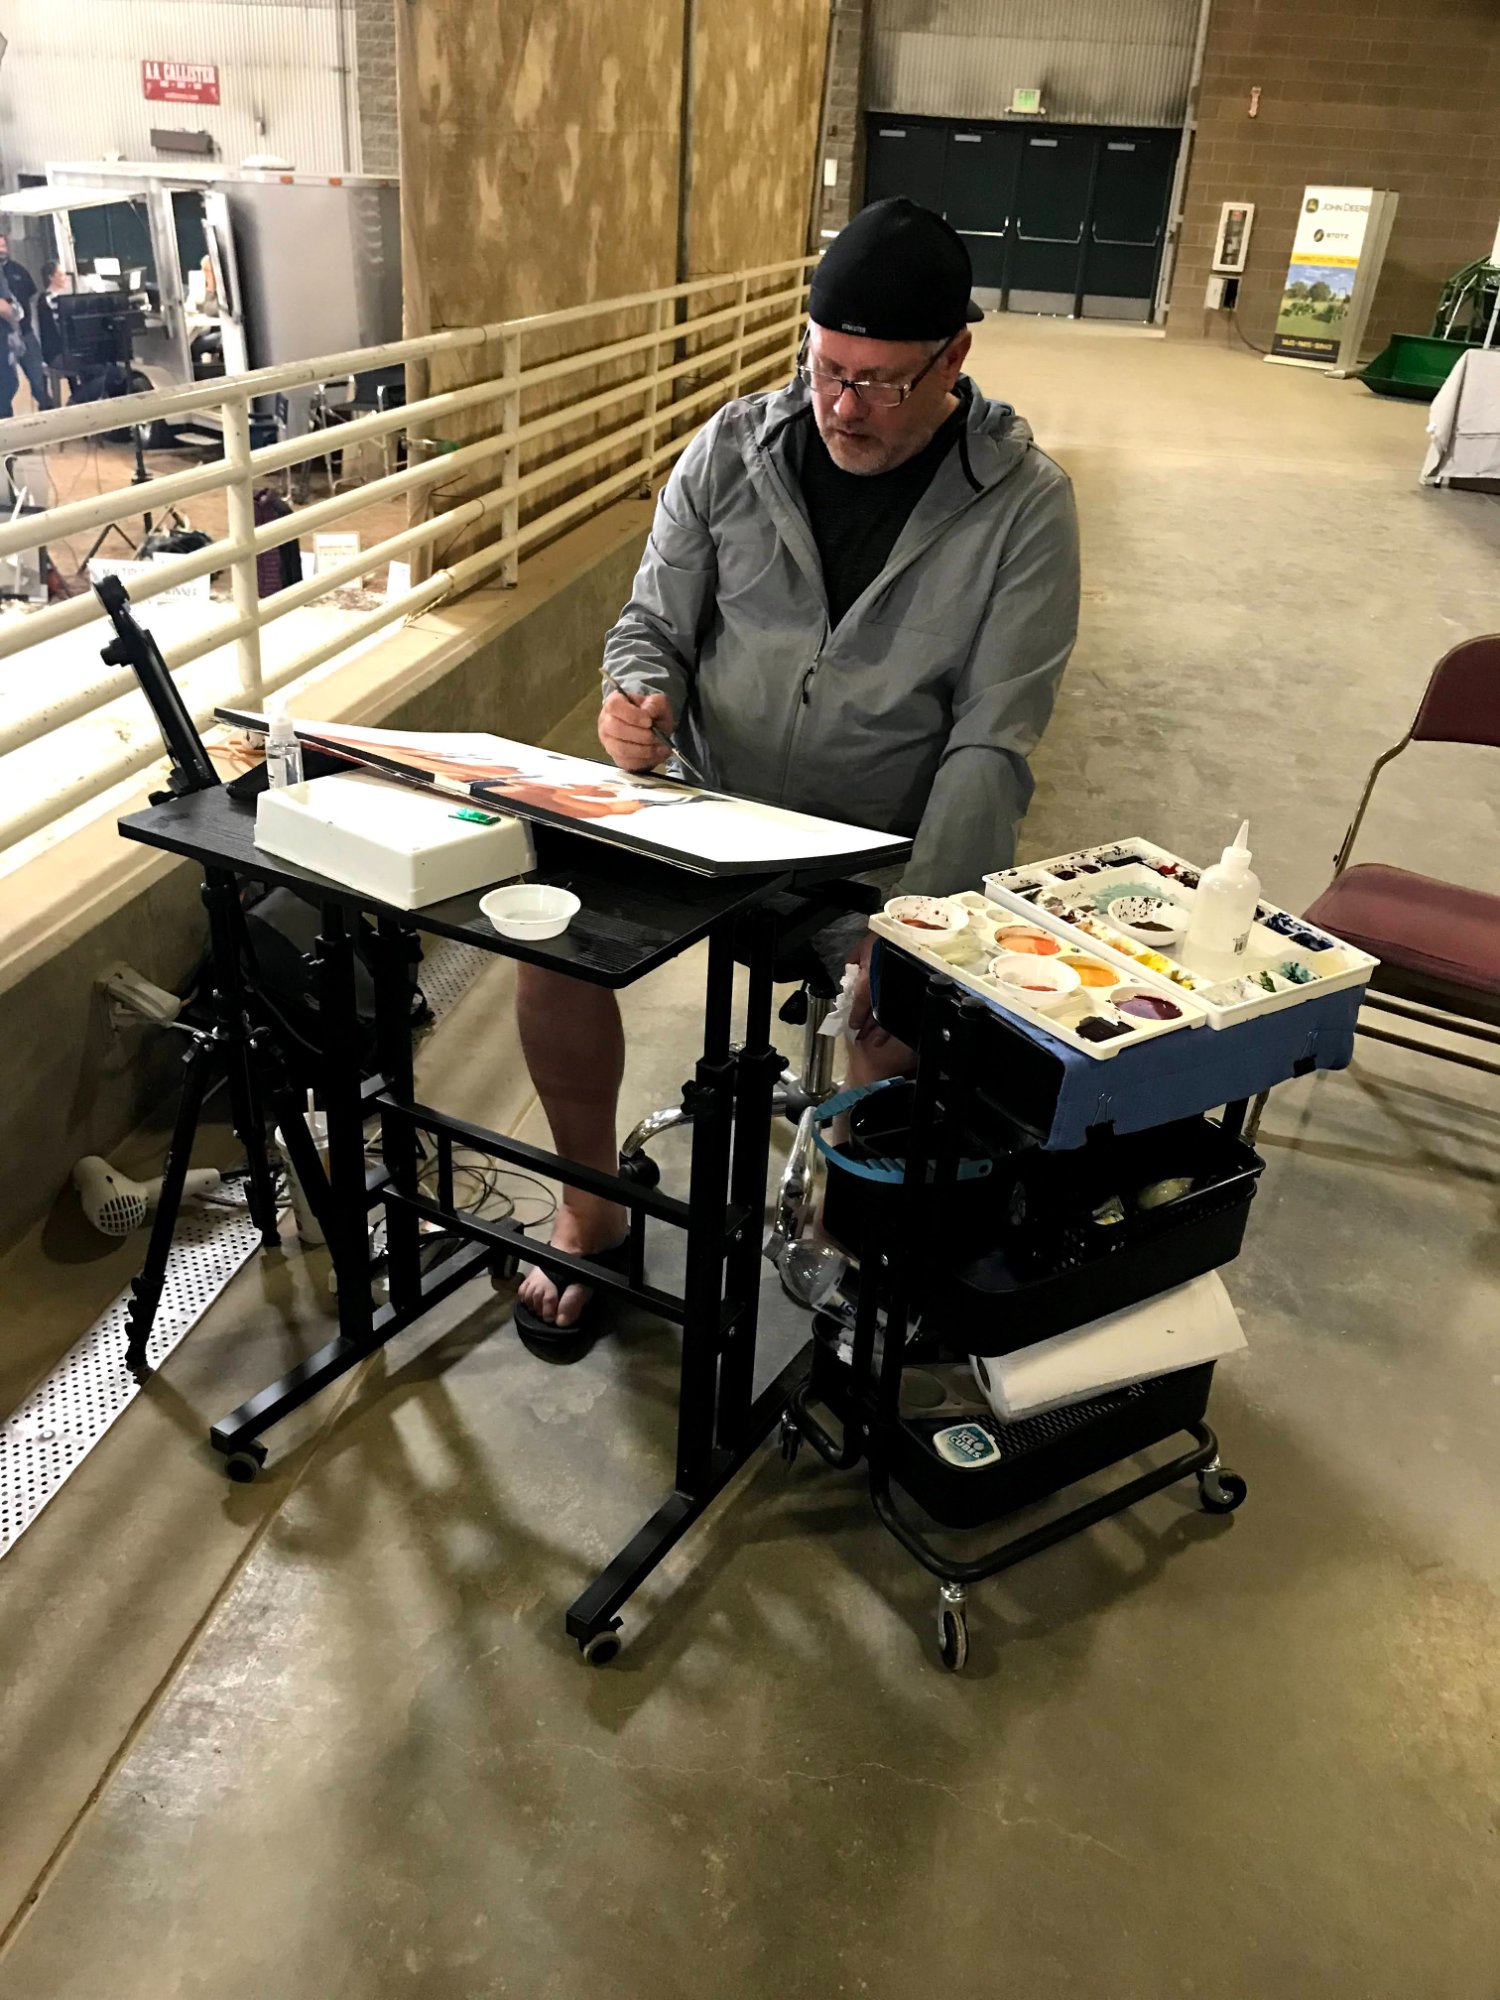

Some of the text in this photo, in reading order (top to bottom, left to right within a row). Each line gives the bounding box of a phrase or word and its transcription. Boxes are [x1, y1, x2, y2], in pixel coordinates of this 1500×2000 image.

[163, 63, 216, 84] CALLISTER
[1321, 203, 1369, 213] JOHN DEERE
[950, 1435, 982, 1458] CUBES
[958, 1431, 975, 1446] ICE
